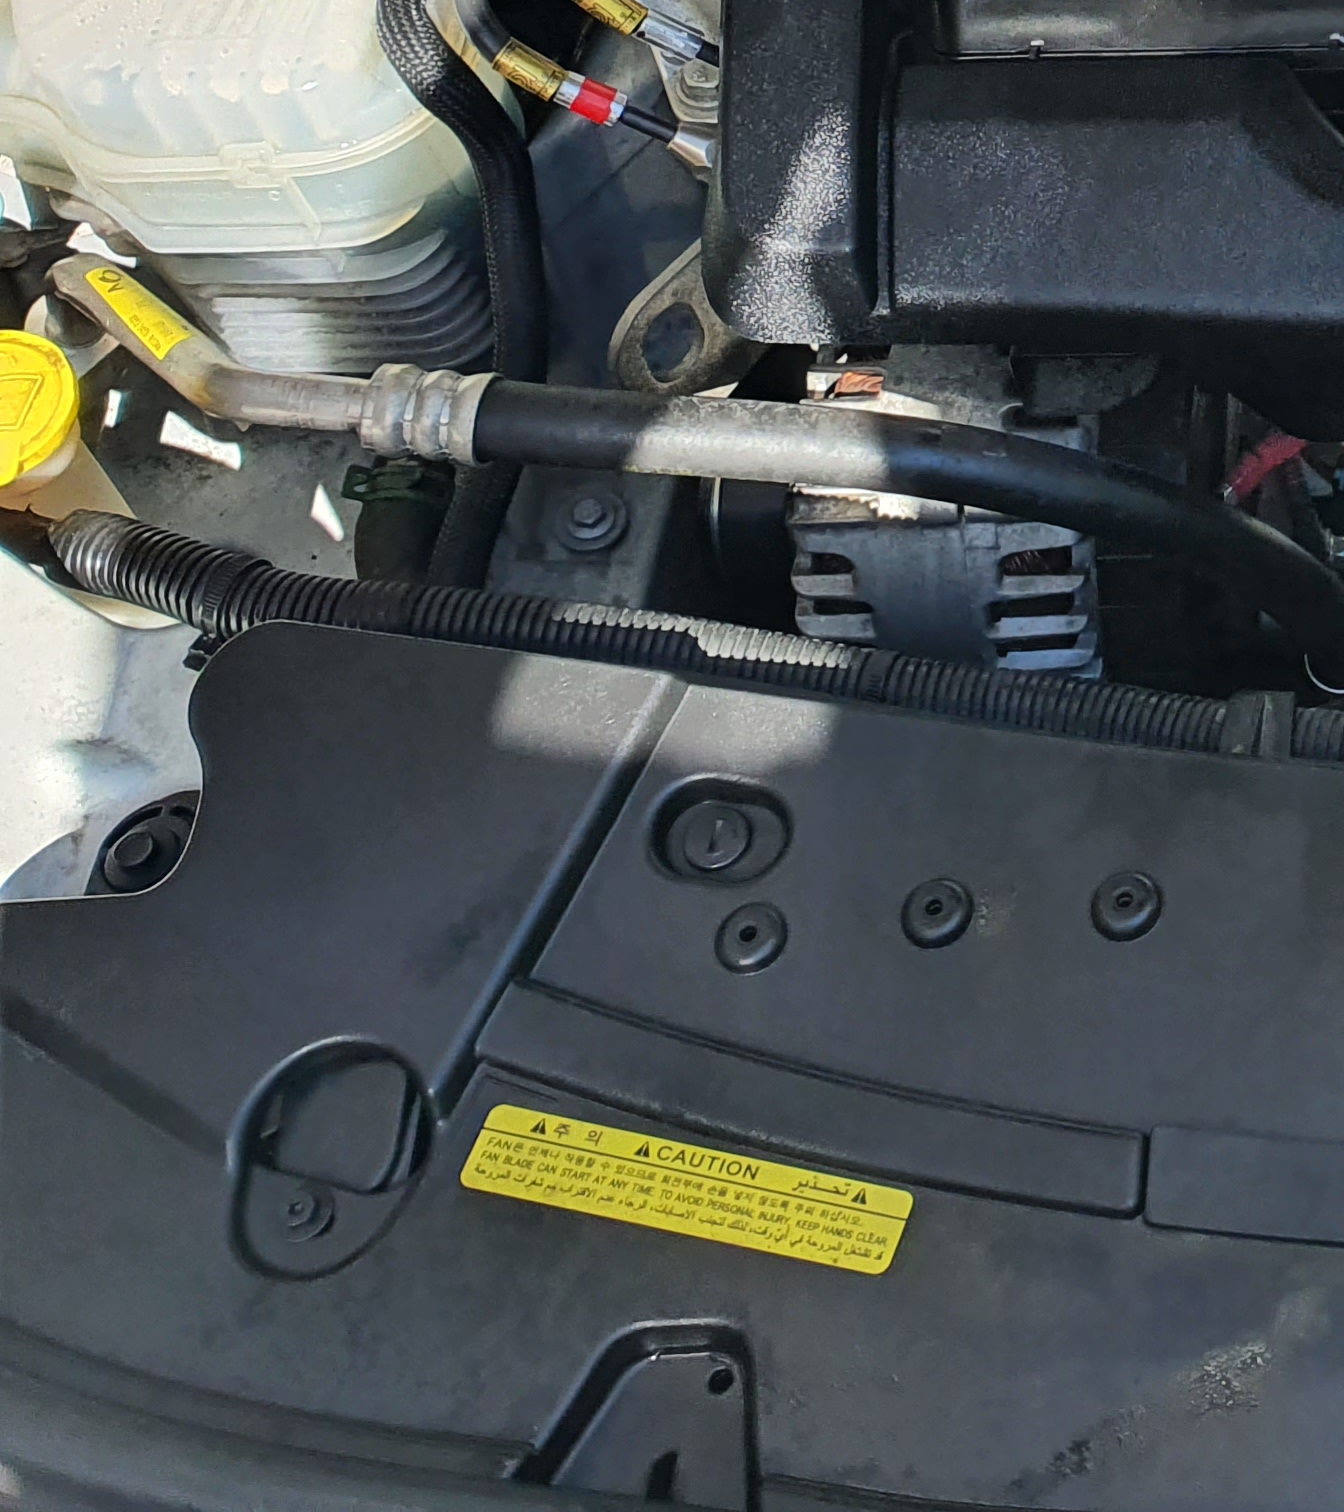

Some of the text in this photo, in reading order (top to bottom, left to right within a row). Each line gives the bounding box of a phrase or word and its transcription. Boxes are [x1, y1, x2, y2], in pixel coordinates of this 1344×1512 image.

[600, 1160, 611, 1172] 수
[656, 1145, 761, 1181] CAUTION
[479, 1150, 501, 1165] FAN
[502, 1154, 535, 1170] BLADE
[537, 1162, 558, 1176] CAN
[559, 1167, 591, 1183] START
[593, 1174, 607, 1186] AT
[608, 1177, 631, 1190] ANY
[631, 1182, 656, 1197] TIME
[659, 1188, 674, 1201] TO
[674, 1193, 705, 1208] AVOID
[706, 1198, 757, 1219] PERSONAL
[794, 1218, 820, 1233] KEEP
[821, 1224, 853, 1240] HANDS
